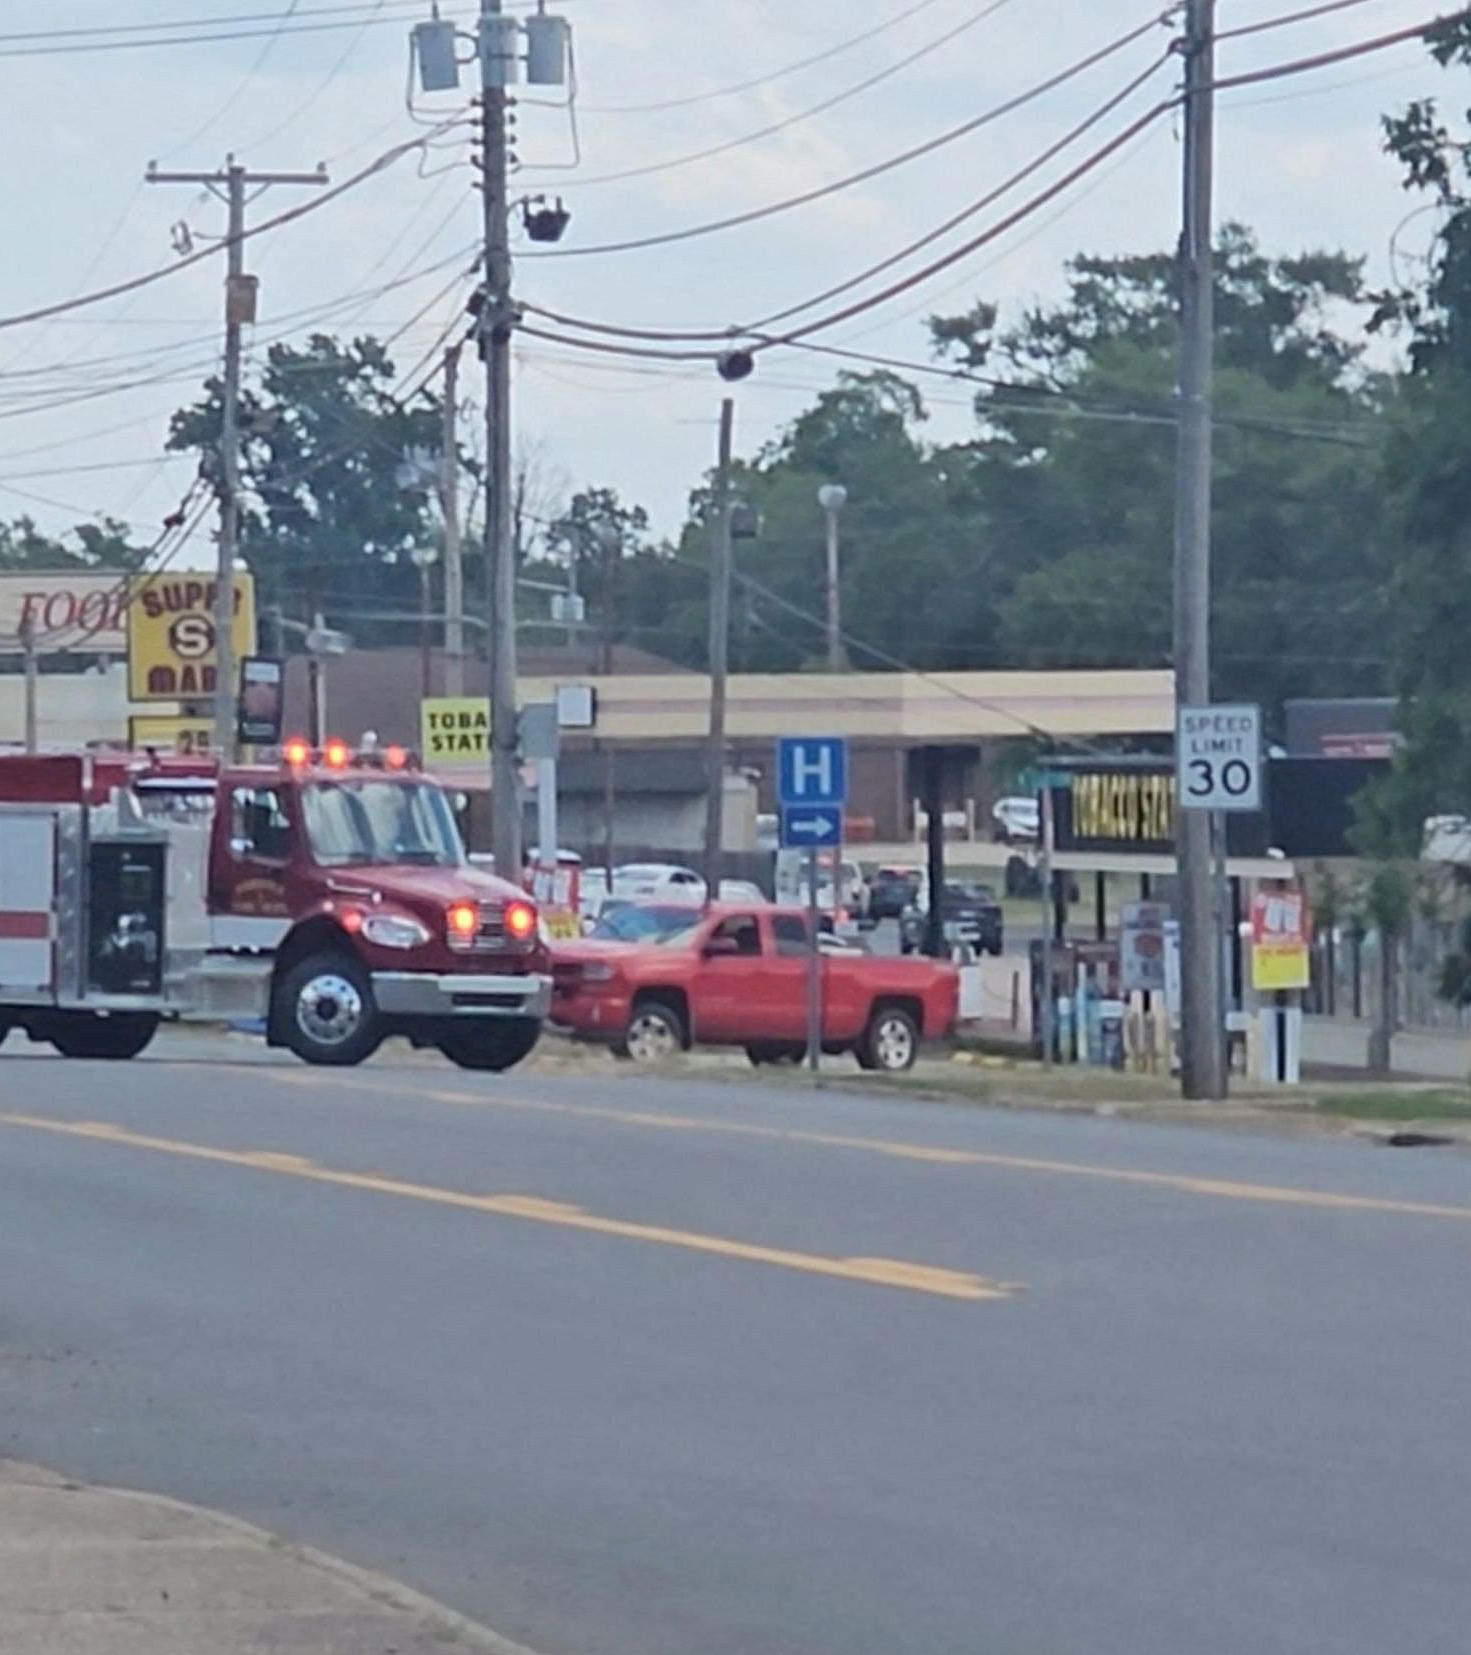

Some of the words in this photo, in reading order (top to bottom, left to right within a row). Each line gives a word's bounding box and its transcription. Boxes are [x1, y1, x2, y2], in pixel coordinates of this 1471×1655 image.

[1185, 715, 1253, 734] SPEED
[1191, 737, 1243, 756] LIMIT
[792, 744, 831, 796] H
[1187, 758, 1252, 797] 30
